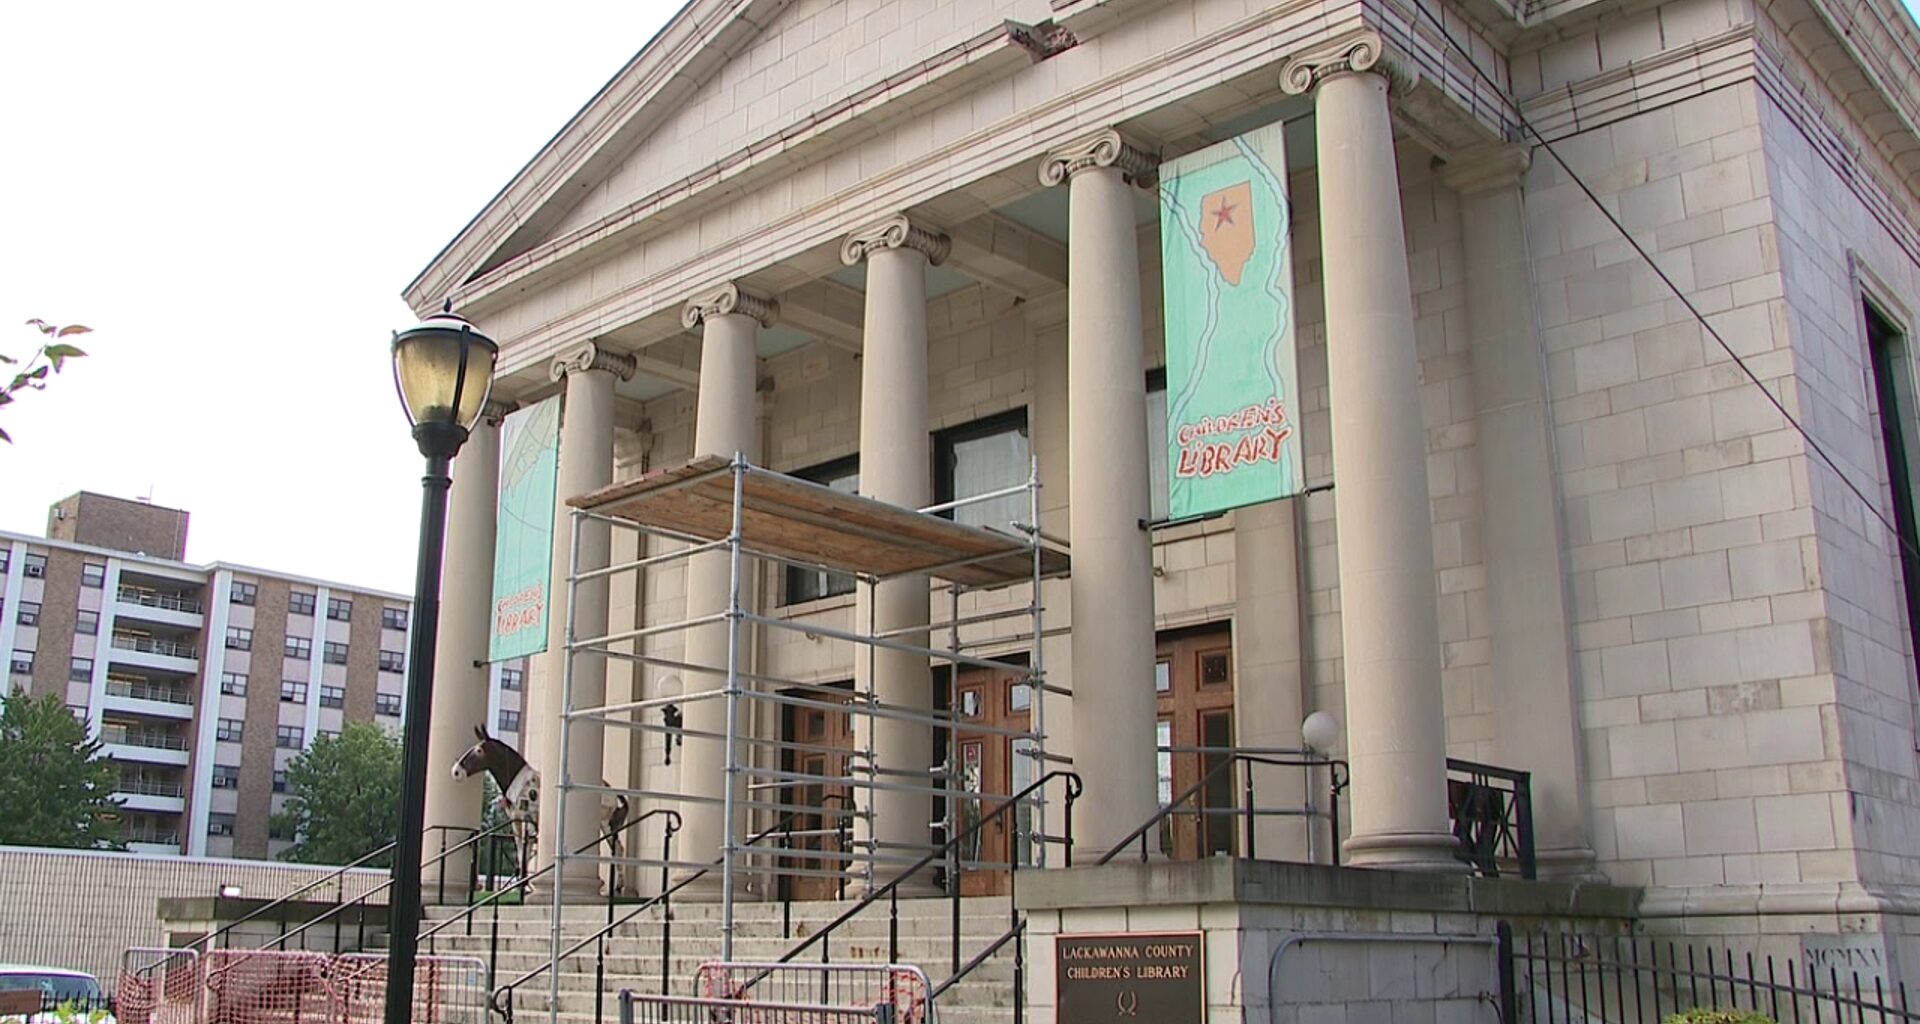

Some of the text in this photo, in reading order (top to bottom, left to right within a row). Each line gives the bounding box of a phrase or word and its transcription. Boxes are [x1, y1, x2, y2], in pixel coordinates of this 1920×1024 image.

[1063, 944, 1193, 960] LACKAWANNA COUNTY
[1067, 965, 1188, 979] CHILDREN'S LIBRARY
